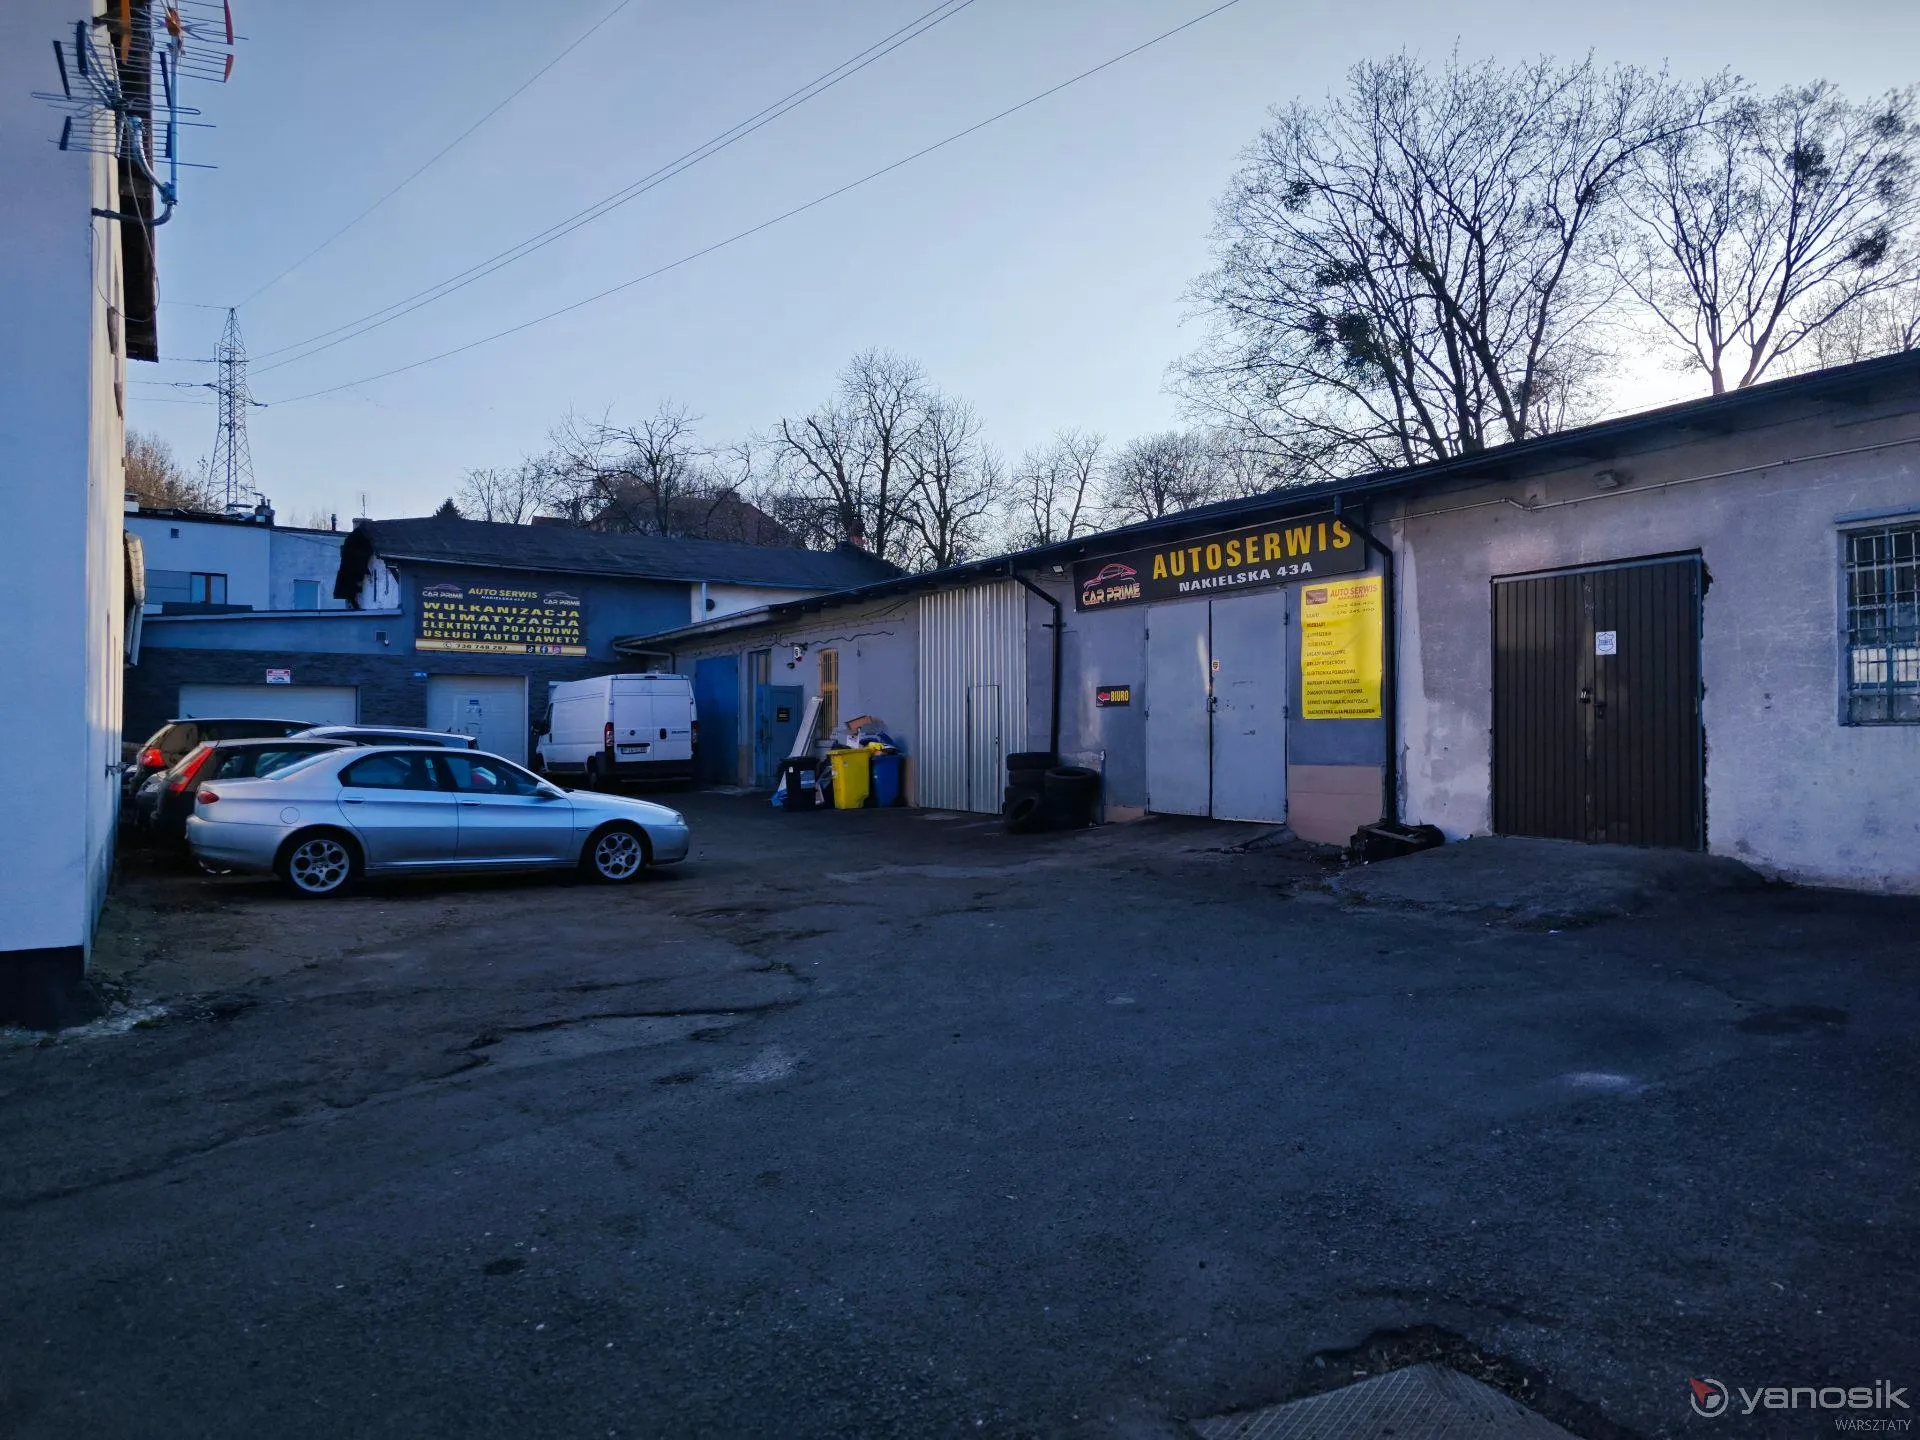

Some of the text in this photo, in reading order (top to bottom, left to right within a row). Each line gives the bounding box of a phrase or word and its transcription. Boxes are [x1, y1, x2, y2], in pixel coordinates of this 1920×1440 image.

[1152, 520, 1351, 580] AUTOSERWIS
[1179, 562, 1313, 592] NAKIELSKA 43A
[422, 590, 464, 599] CAR PRIME
[468, 587, 538, 598] AUTO SERWIS
[1082, 582, 1141, 605] CAR PRIME
[1330, 588, 1349, 598] AUTO
[1350, 584, 1377, 595] SERWIS
[423, 601, 580, 618] WULKANIZACJA
[559, 599, 581, 607] PRIME
[423, 611, 579, 627] KLIMATYZACJA
[422, 620, 580, 635] ELEKTRYKA POJAZDOWA
[423, 629, 579, 644] USŁUGI AUTO LAWETY
[1110, 690, 1129, 702] BIURO
